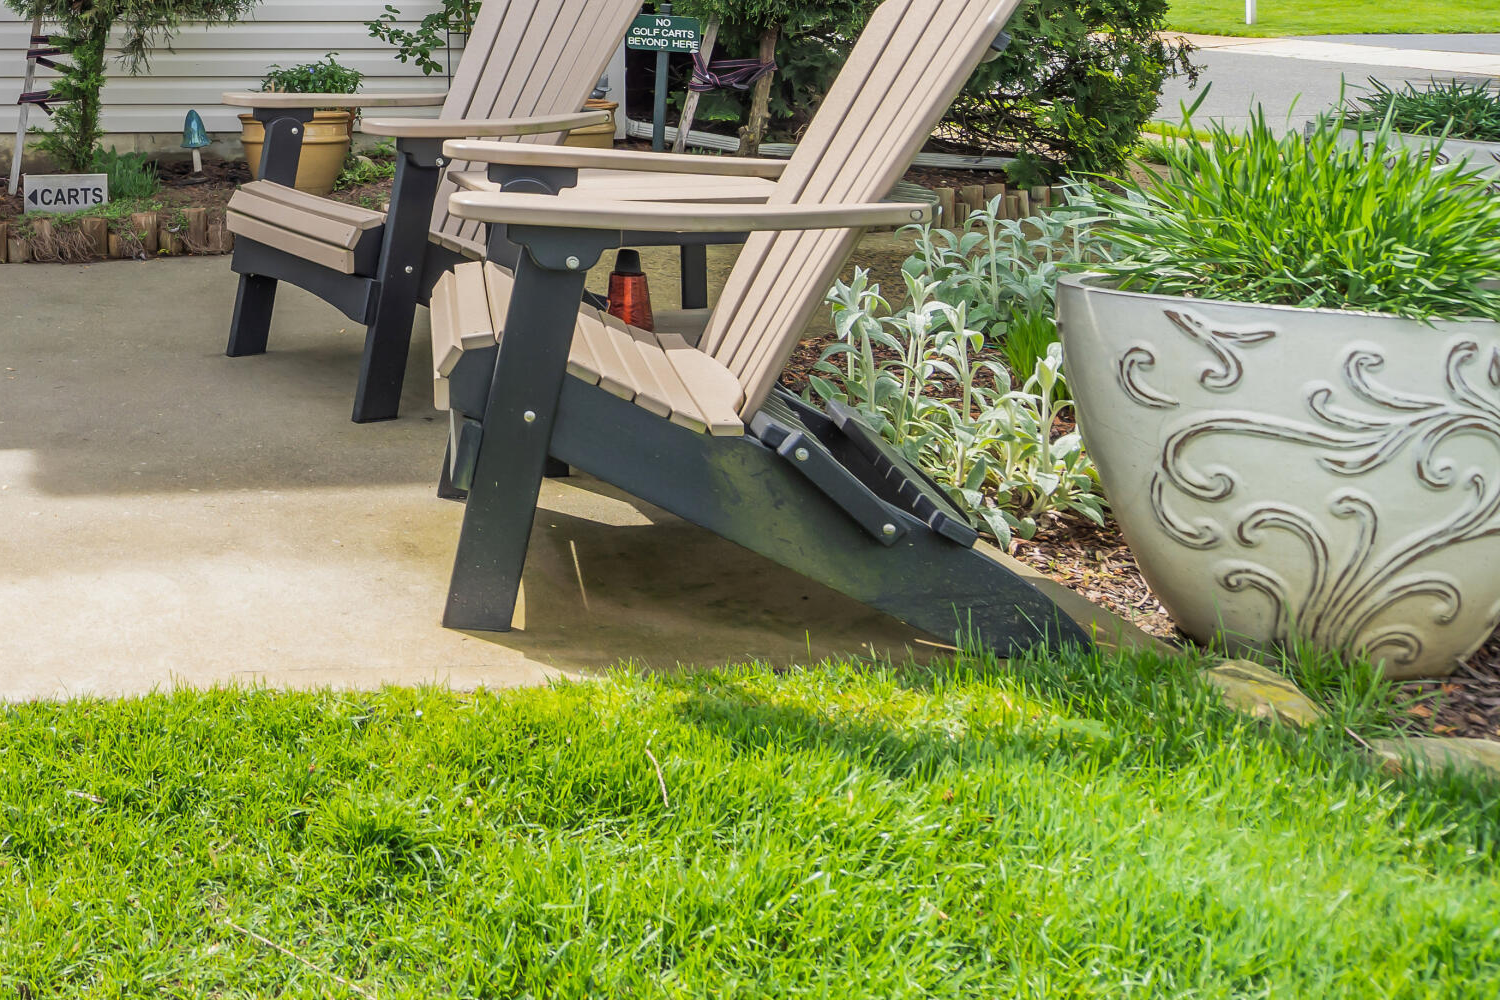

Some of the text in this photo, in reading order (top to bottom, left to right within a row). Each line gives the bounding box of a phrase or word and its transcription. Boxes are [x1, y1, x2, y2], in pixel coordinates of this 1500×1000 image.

[655, 18, 671, 27] NO
[632, 27, 694, 39] GOLF CARTS
[628, 36, 699, 49] BEYOND HERE
[40, 187, 103, 206] CARTS
